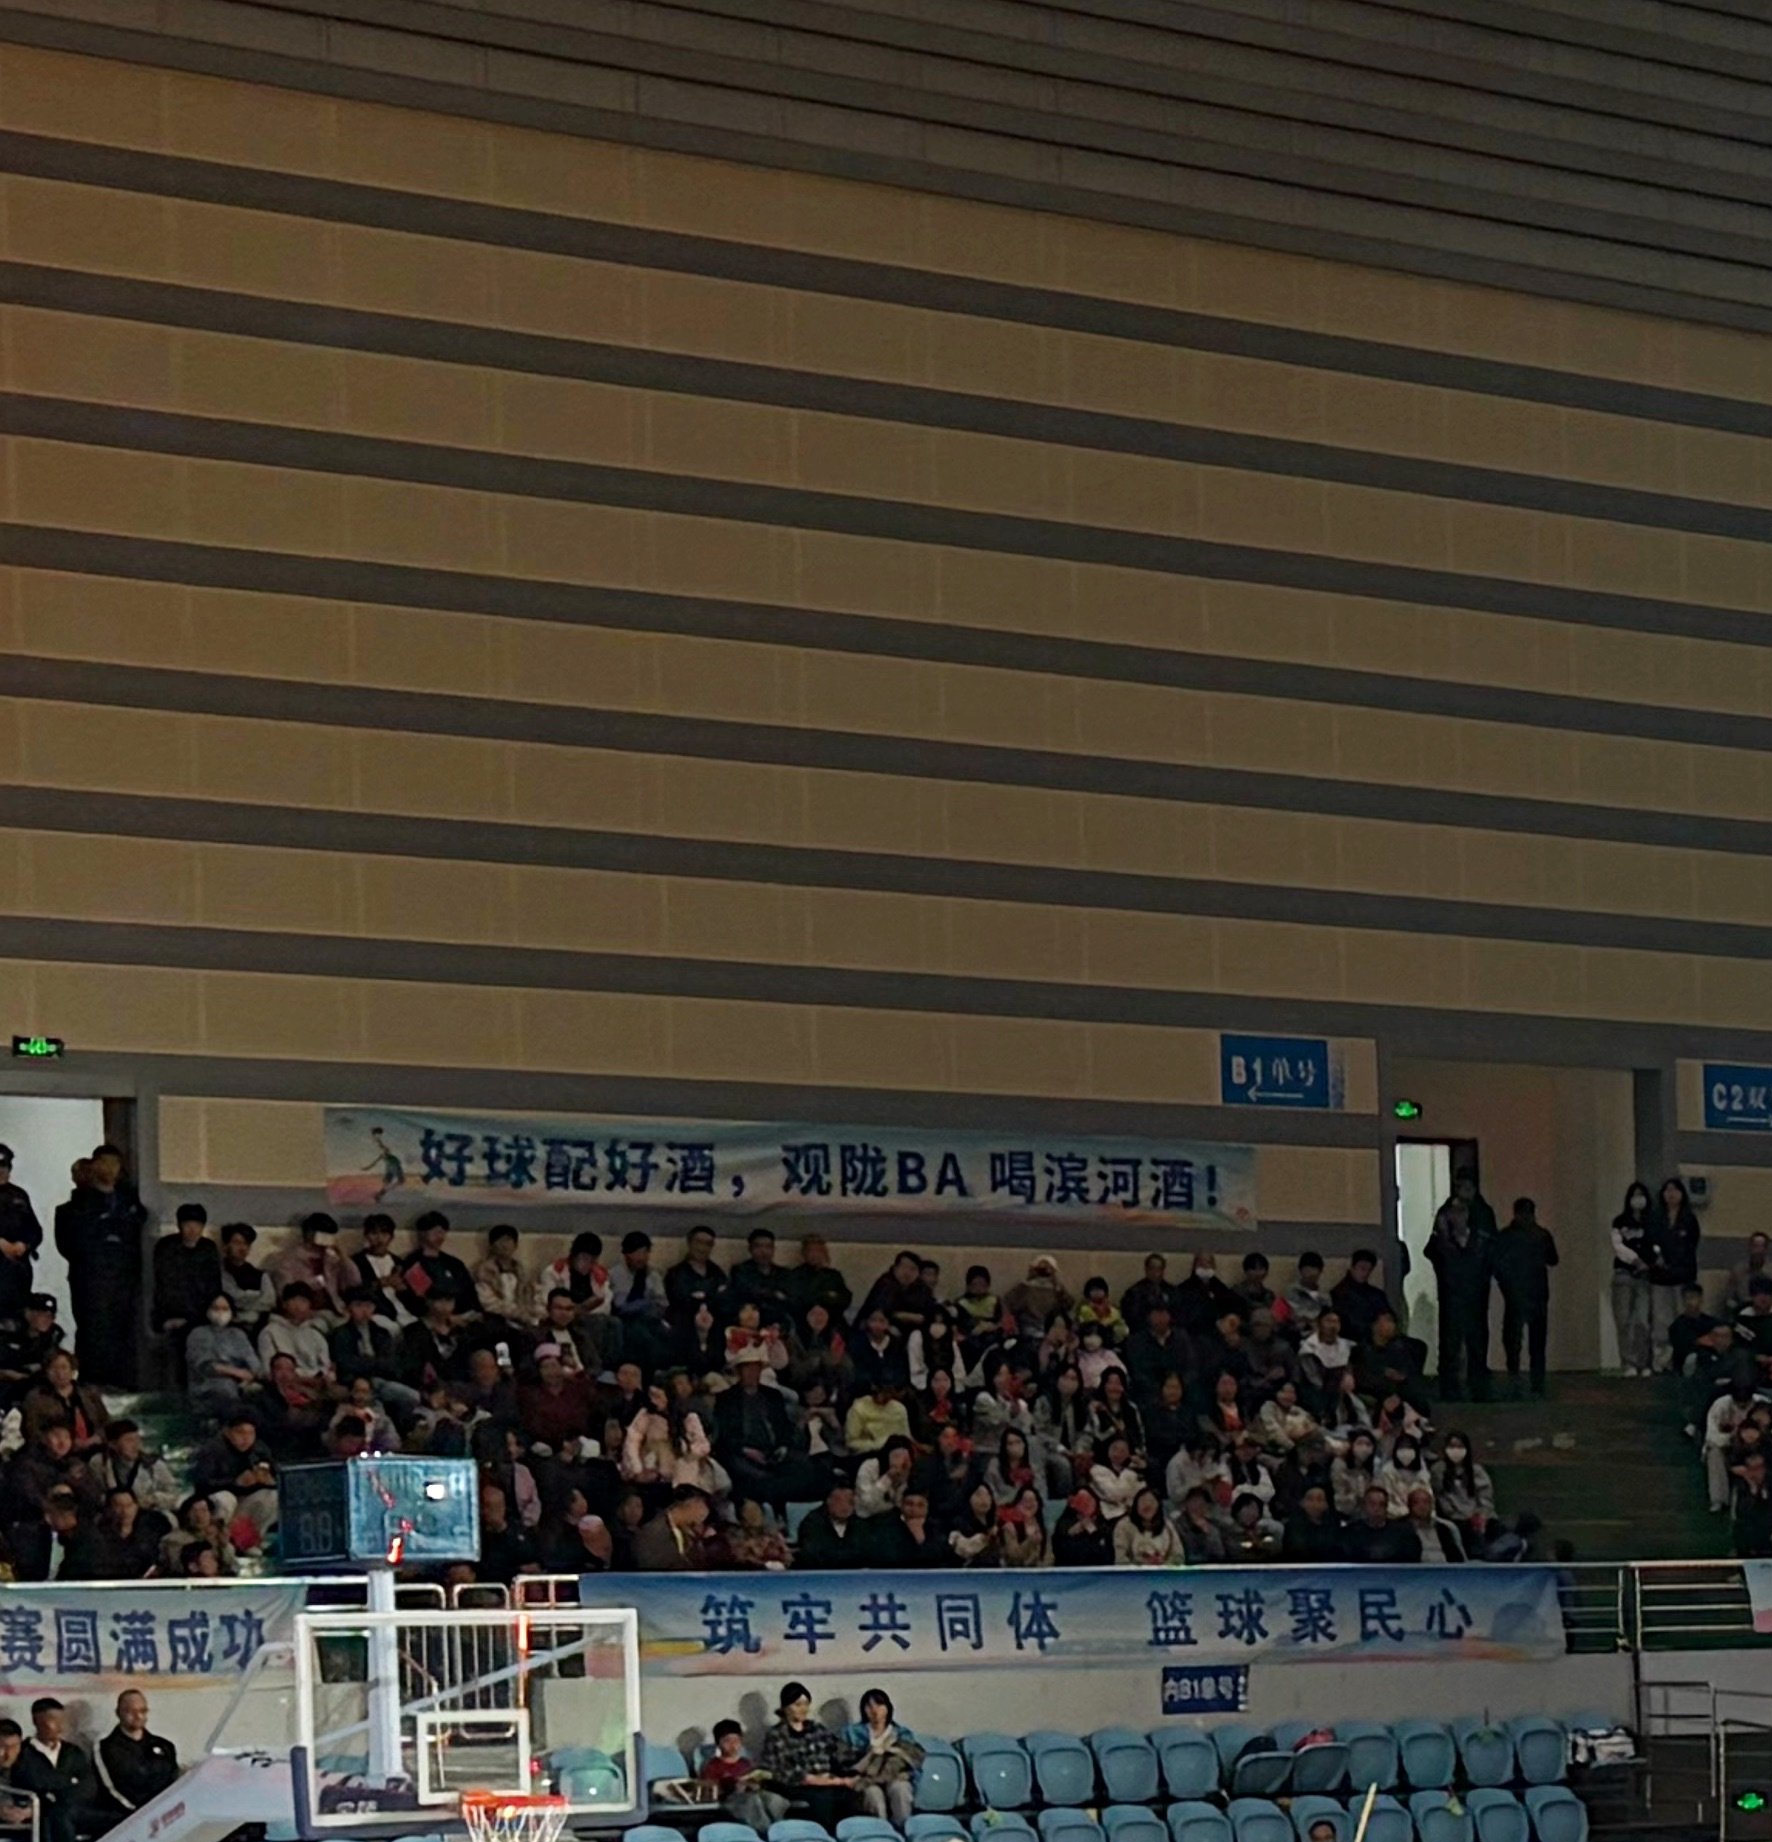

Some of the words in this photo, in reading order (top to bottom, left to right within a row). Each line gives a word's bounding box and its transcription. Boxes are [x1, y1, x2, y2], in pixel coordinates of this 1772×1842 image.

[0, 1605, 266, 1675] 赛圆满成功
[699, 1591, 1061, 1655] 筑牢共同体
[1145, 1587, 1474, 1647] 篮球聚民心
